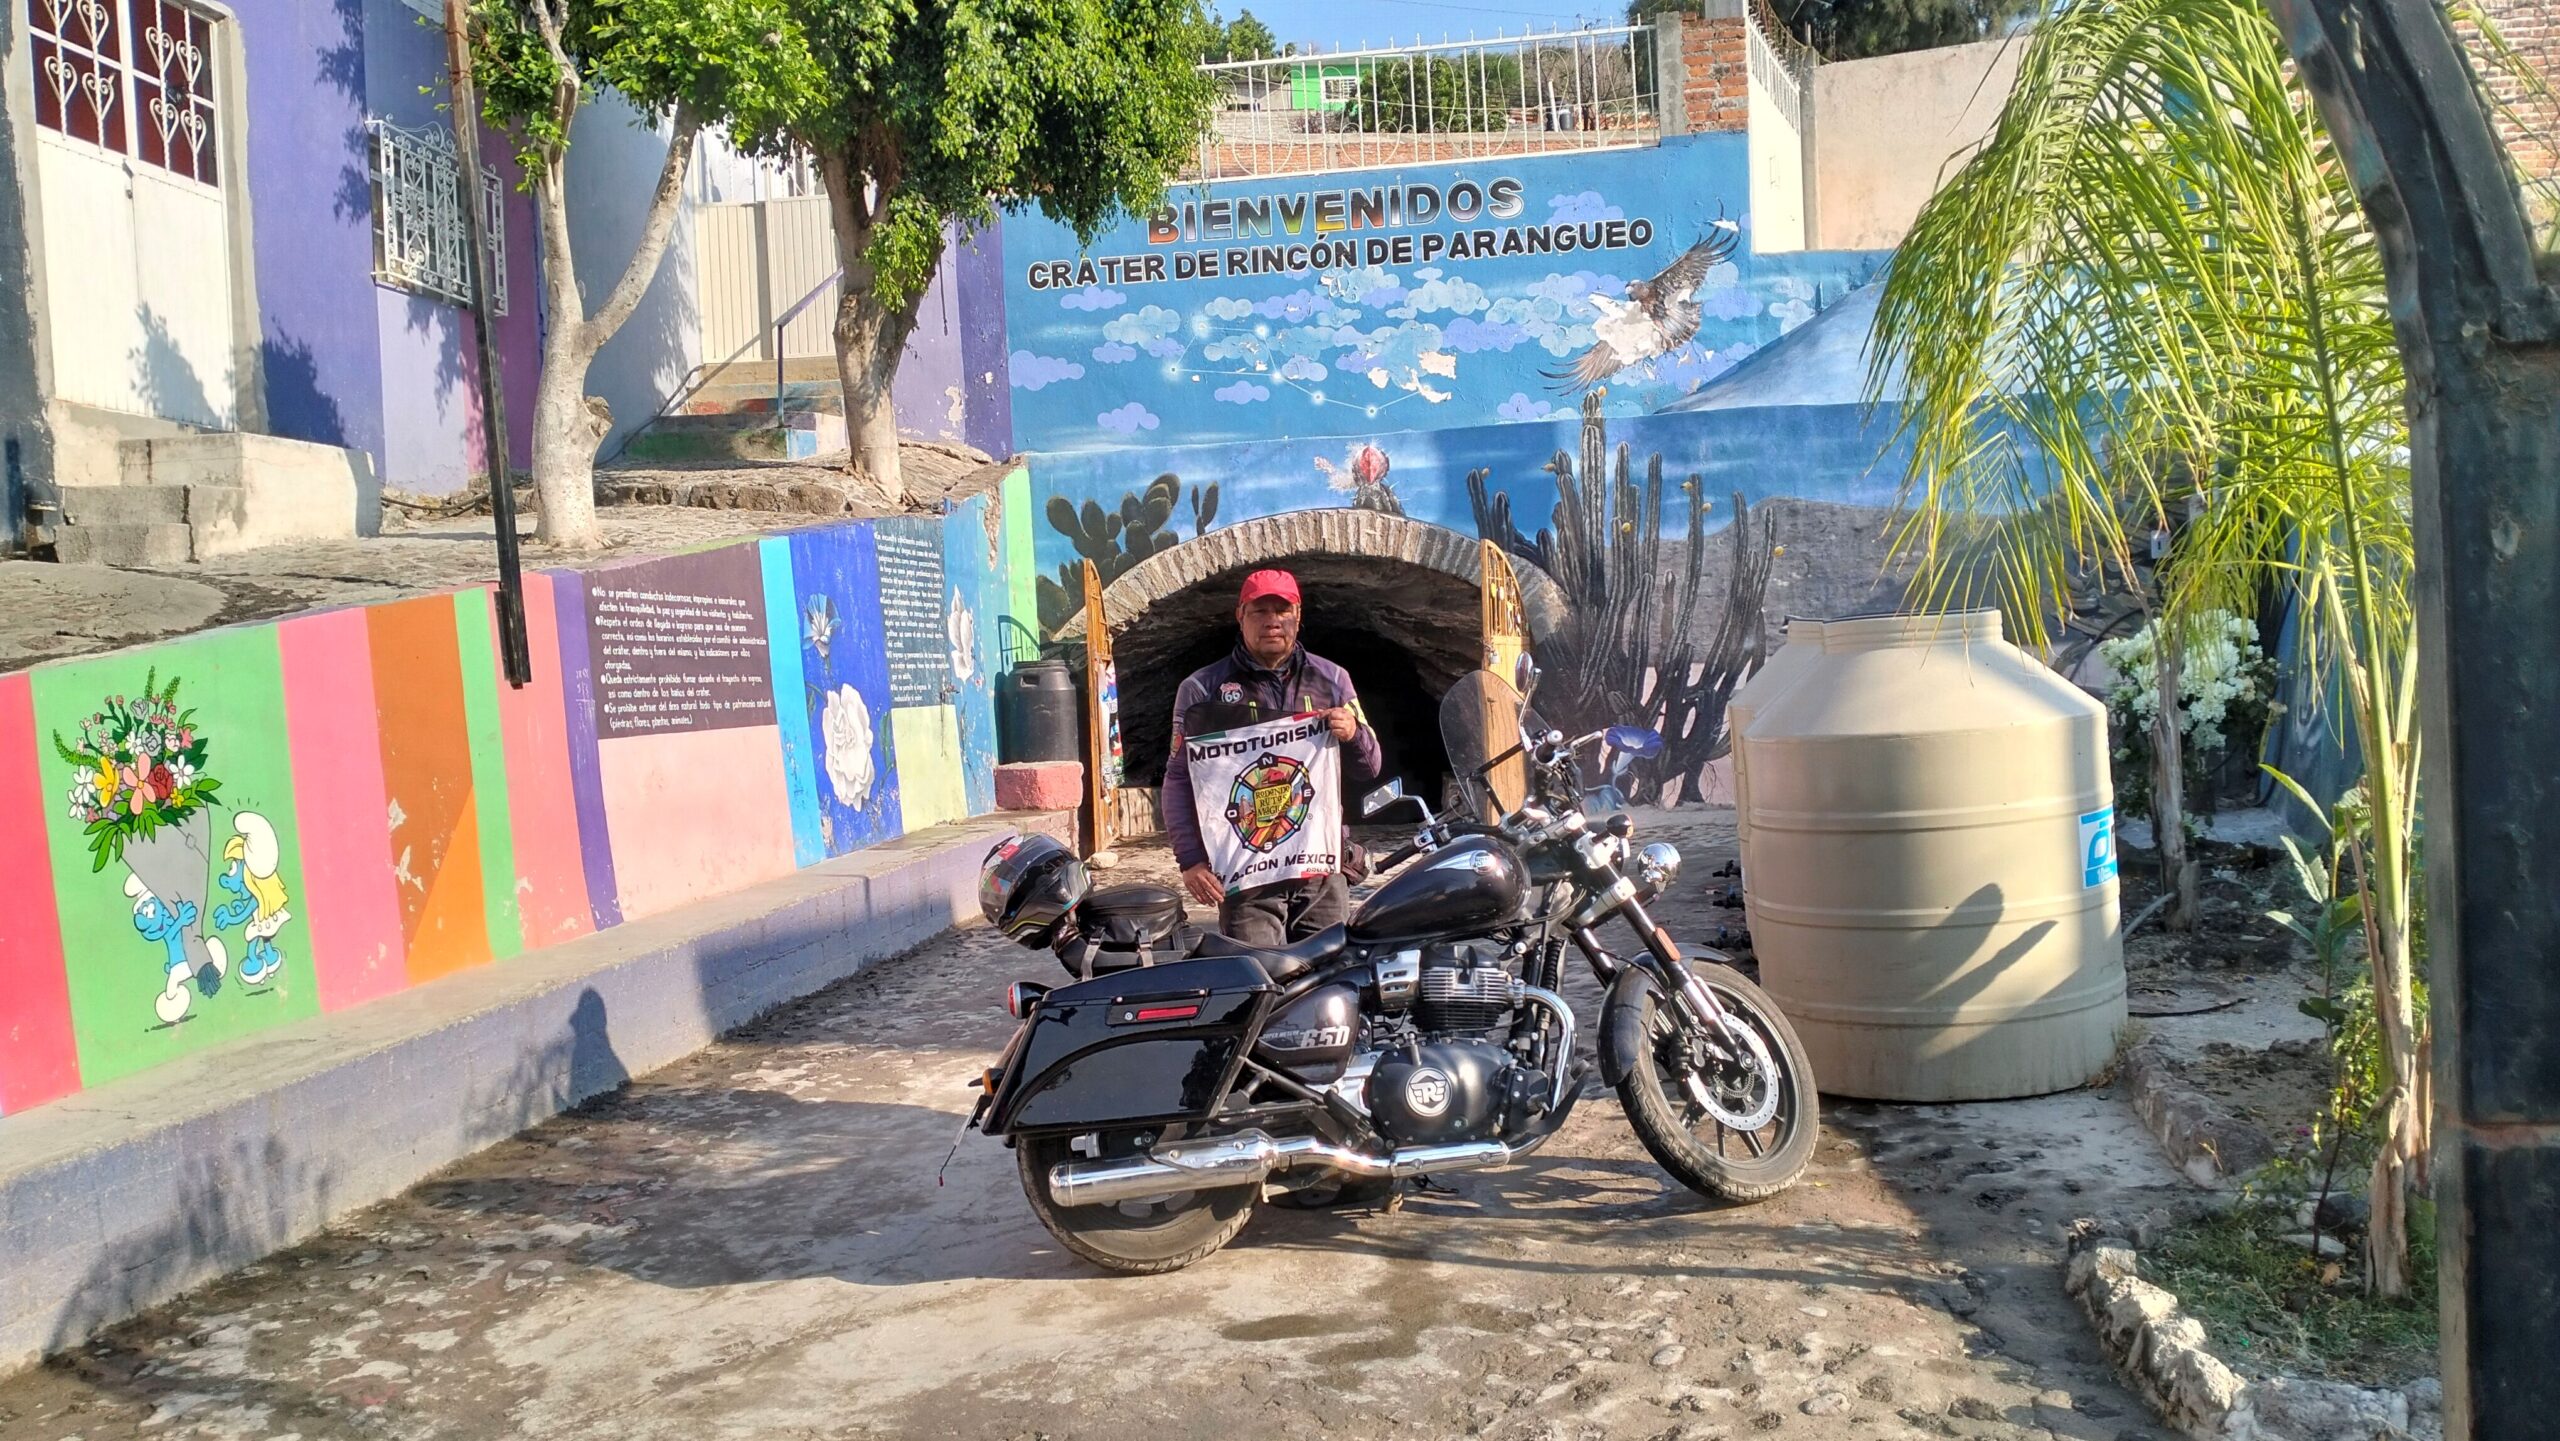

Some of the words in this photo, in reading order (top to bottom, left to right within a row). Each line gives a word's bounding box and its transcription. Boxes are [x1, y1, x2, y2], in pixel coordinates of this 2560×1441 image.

[1147, 177, 1525, 245] BIENVENIDOS
[1174, 249, 1219, 280] DE
[1226, 233, 1357, 277] RINCÓN
[1367, 232, 1414, 266] DE
[1422, 217, 1655, 262] PARANGUEO
[1225, 691, 1241, 703] 66
[1262, 756, 1273, 764] N
[1304, 789, 1312, 797] E
[1227, 810, 1238, 818] O
[1264, 842, 1273, 850] S
[1285, 850, 1337, 867] MÉXICO
[1301, 1025, 1350, 1048] 650
